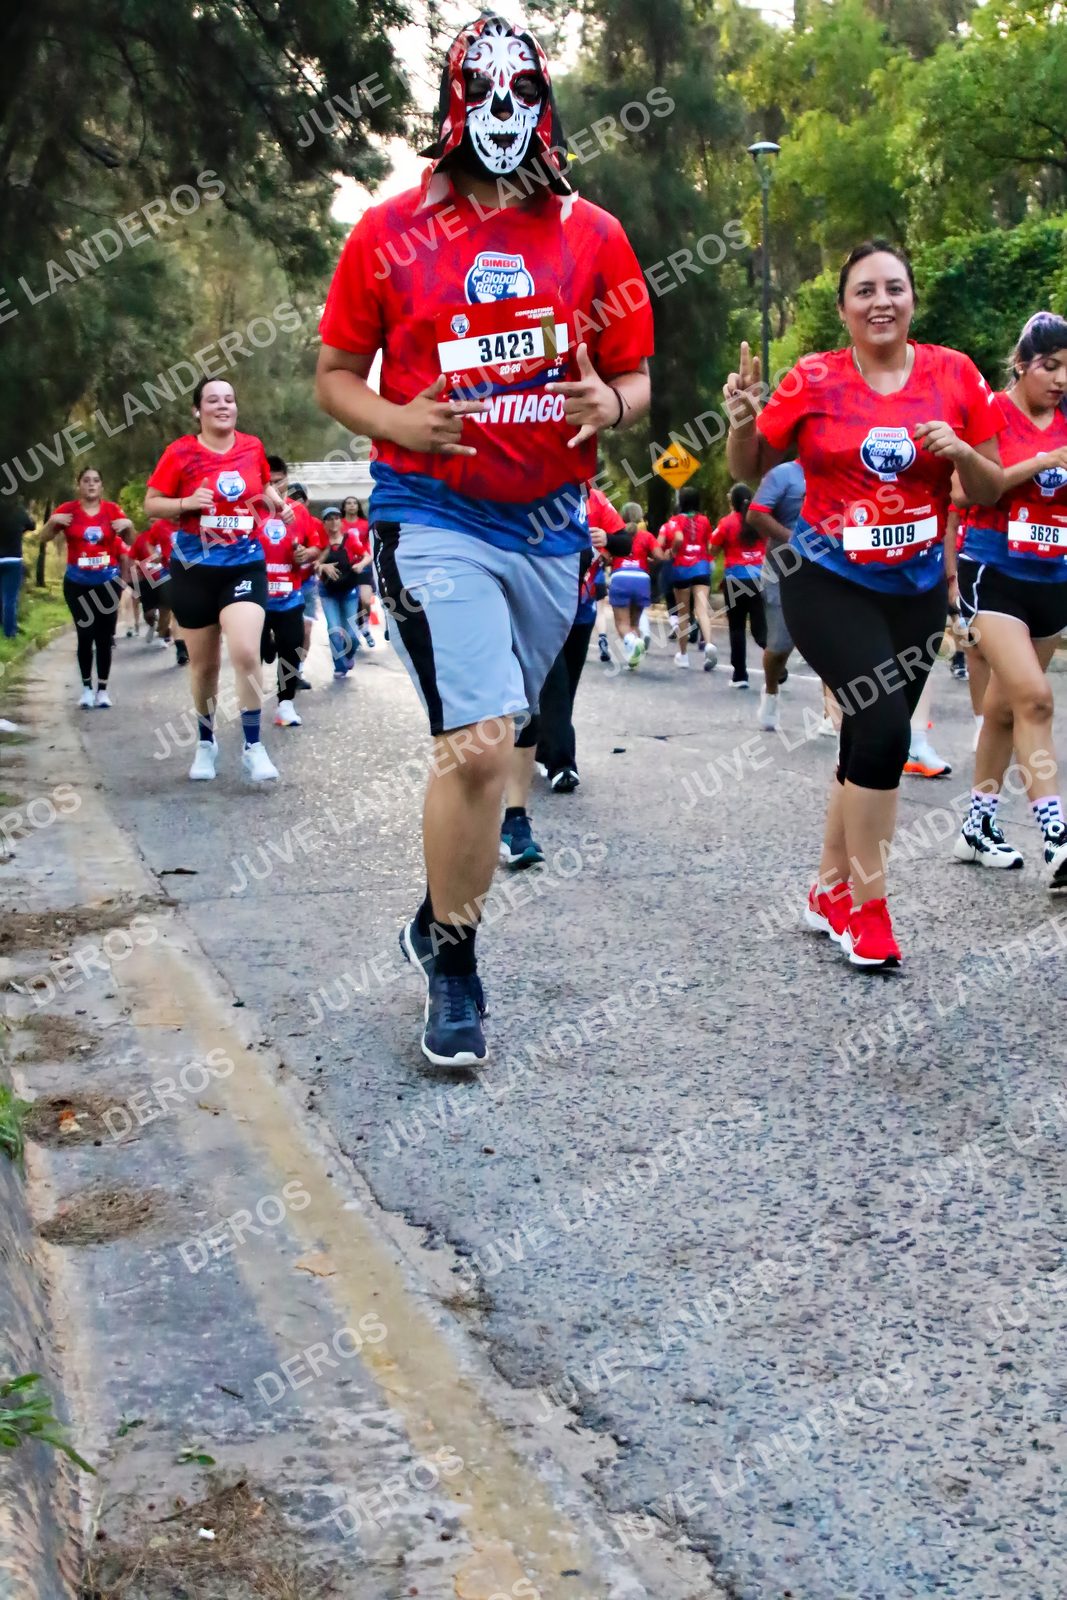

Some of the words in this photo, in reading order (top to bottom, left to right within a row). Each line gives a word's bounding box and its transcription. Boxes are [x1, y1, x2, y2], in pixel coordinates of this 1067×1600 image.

[482, 259, 518, 268] BIMBO
[482, 272, 518, 285] Global
[476, 283, 504, 294] Race
[478, 331, 534, 363] 3423
[467, 394, 566, 424] NTIAGO
[875, 440, 903, 450] Global
[216, 517, 239, 528] 2828
[872, 524, 916, 548] 3009
[1030, 526, 1060, 543] 3626
